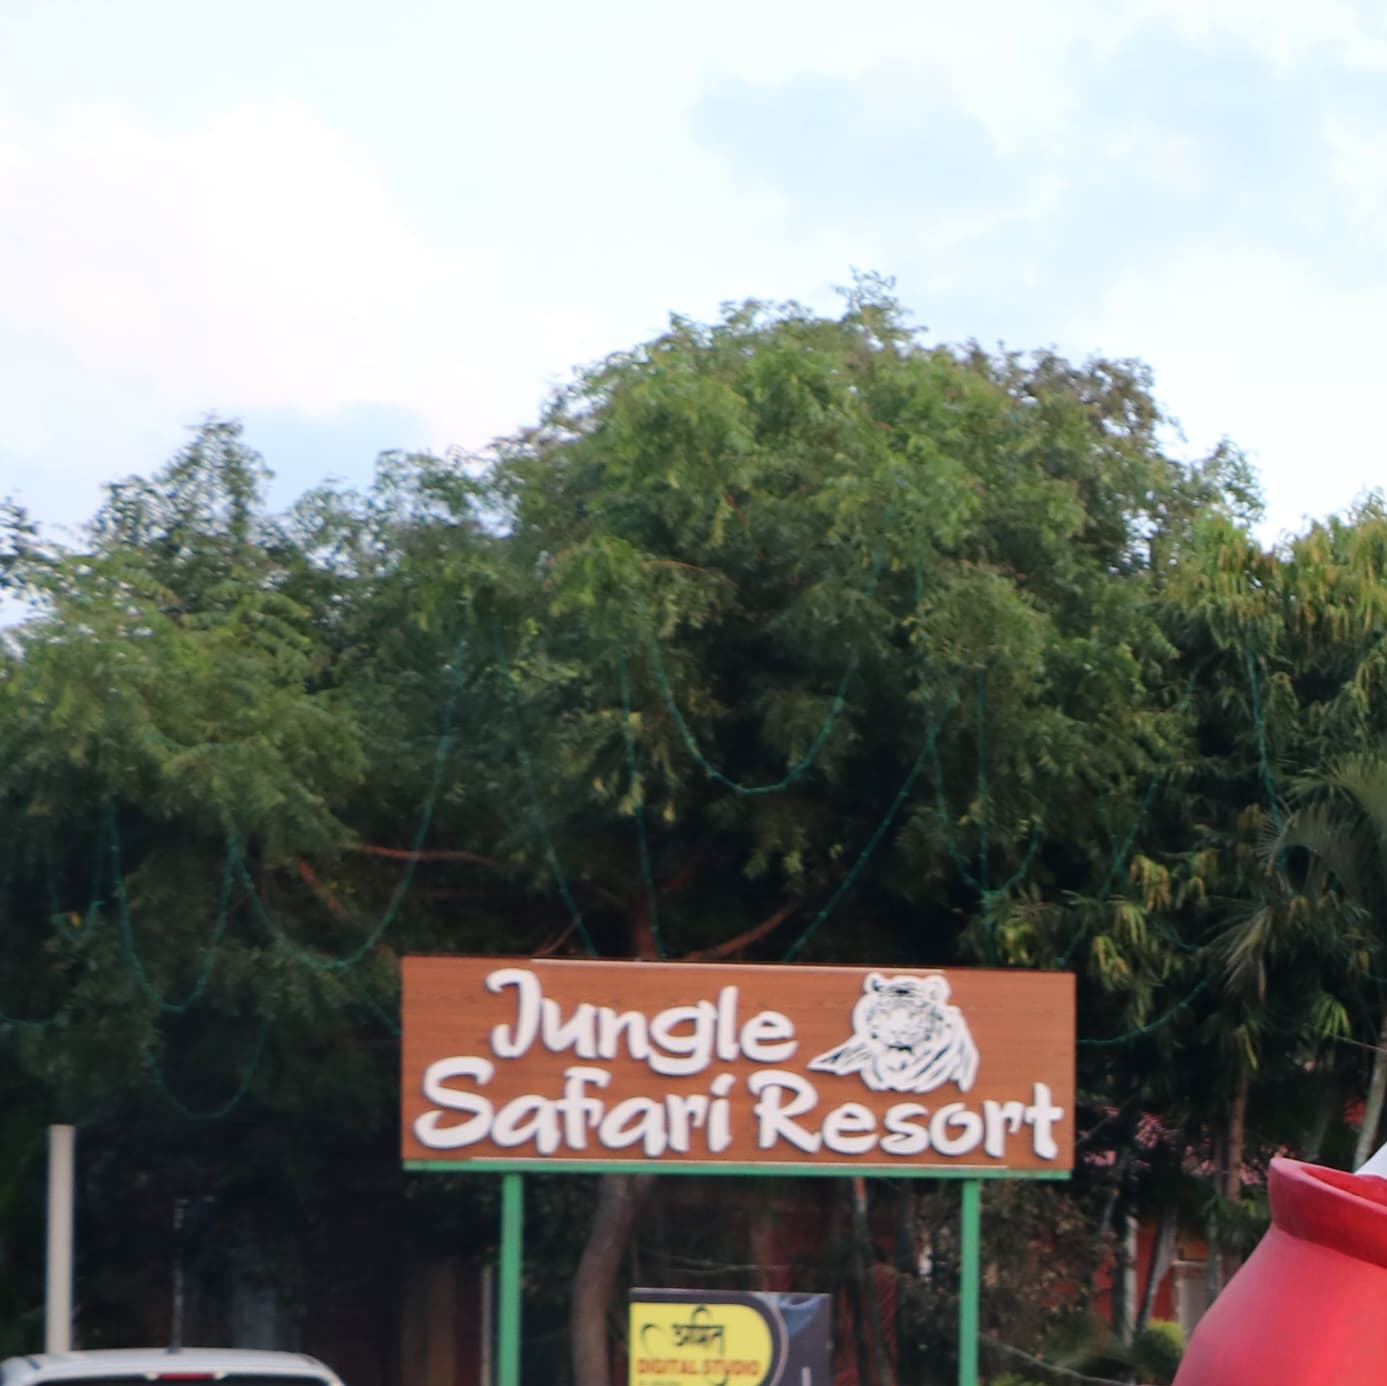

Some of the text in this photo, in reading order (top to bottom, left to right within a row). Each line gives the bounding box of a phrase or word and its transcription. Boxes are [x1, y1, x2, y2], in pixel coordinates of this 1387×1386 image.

[485, 968, 799, 1076] Jungle
[414, 1056, 1065, 1160] Safari Resort
[637, 1358, 698, 1376] DIGITAL
